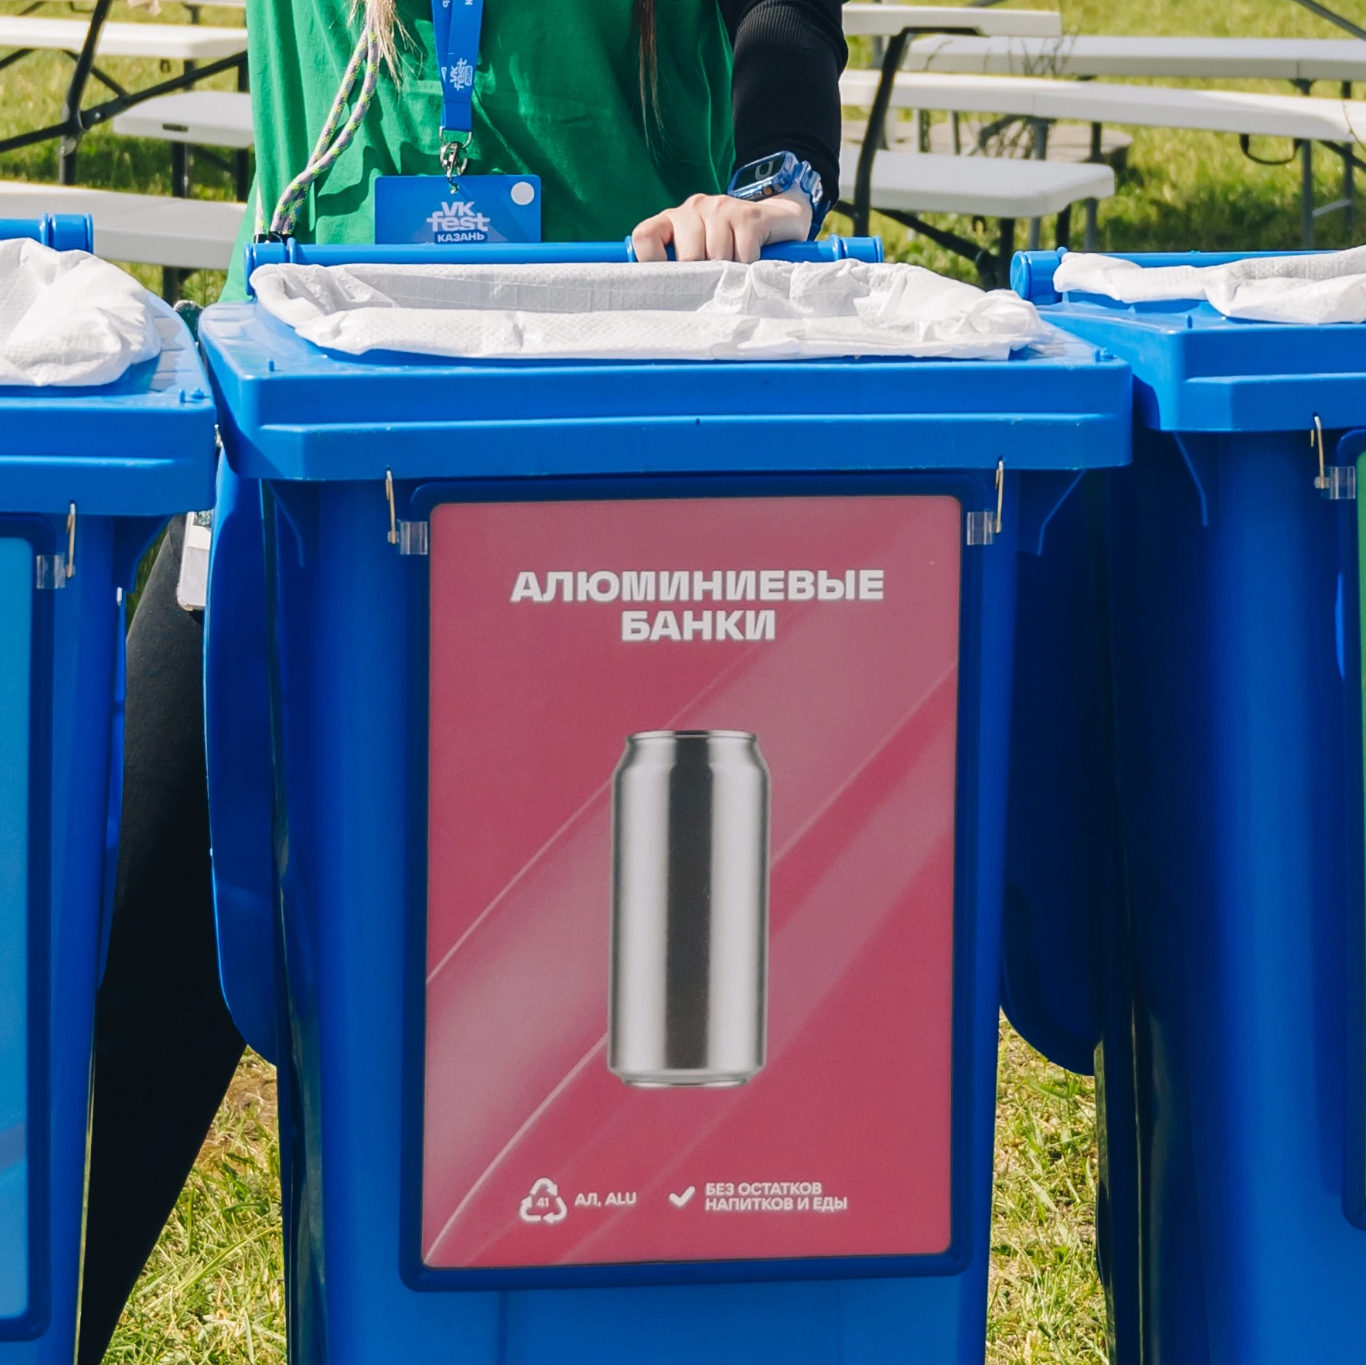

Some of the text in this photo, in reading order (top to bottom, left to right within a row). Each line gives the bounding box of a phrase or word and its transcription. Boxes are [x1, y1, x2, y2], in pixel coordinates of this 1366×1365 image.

[454, 58, 467, 91] fest
[441, 201, 475, 216] VK
[426, 211, 490, 232] fest
[437, 233, 485, 242] КАЗАНЬ
[509, 569, 885, 603] АЛЮМИНИЕВЫЕ
[620, 609, 776, 642] БАНКИ
[705, 1182, 823, 1196] БЕЗ ОСТАТКОВ
[536, 1197, 550, 1208] 41
[574, 1192, 637, 1207] АЛ, ALU
[705, 1196, 847, 1212] НАПИТКОВ И ЕДЫ
